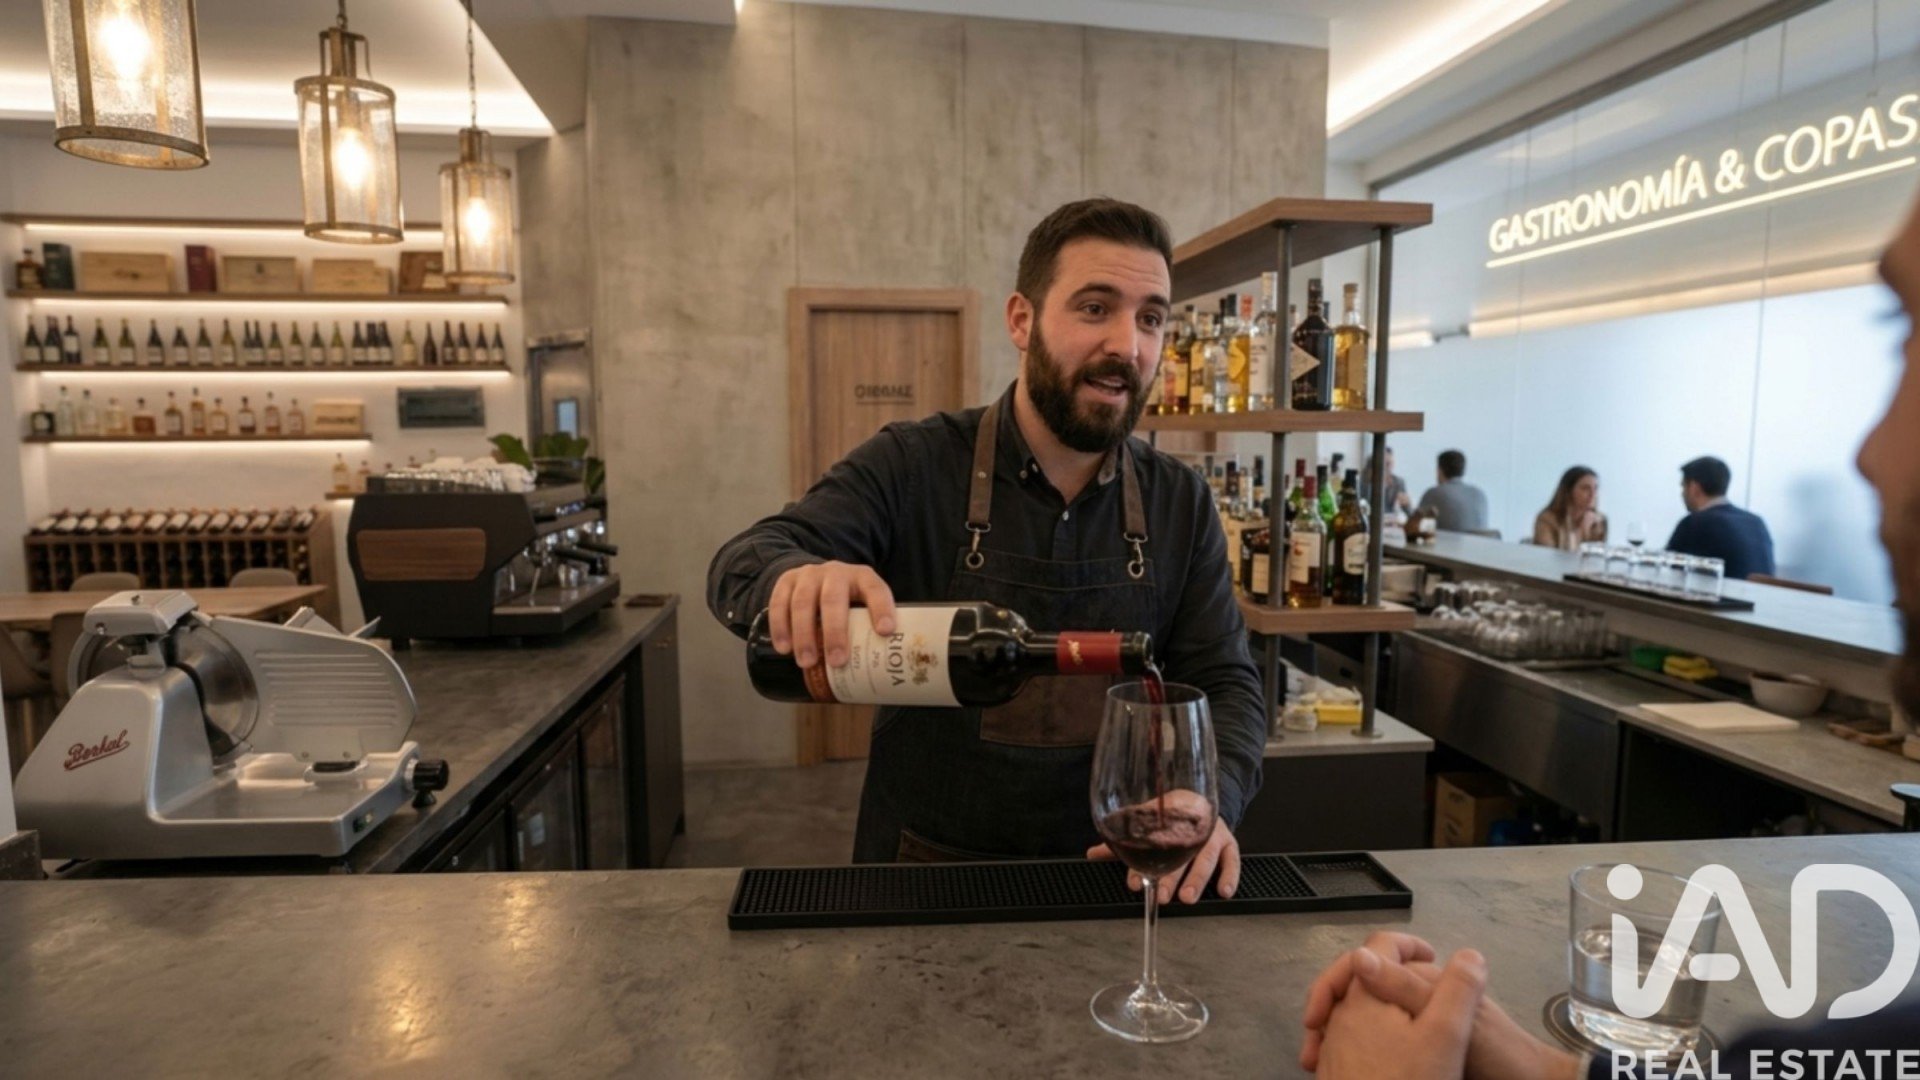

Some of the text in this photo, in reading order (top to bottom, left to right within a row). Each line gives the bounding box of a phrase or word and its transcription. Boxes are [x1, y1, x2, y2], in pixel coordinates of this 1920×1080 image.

[1488, 94, 1919, 253] GASTRONOMÍA & COPAS
[886, 631, 906, 687] RIOJA
